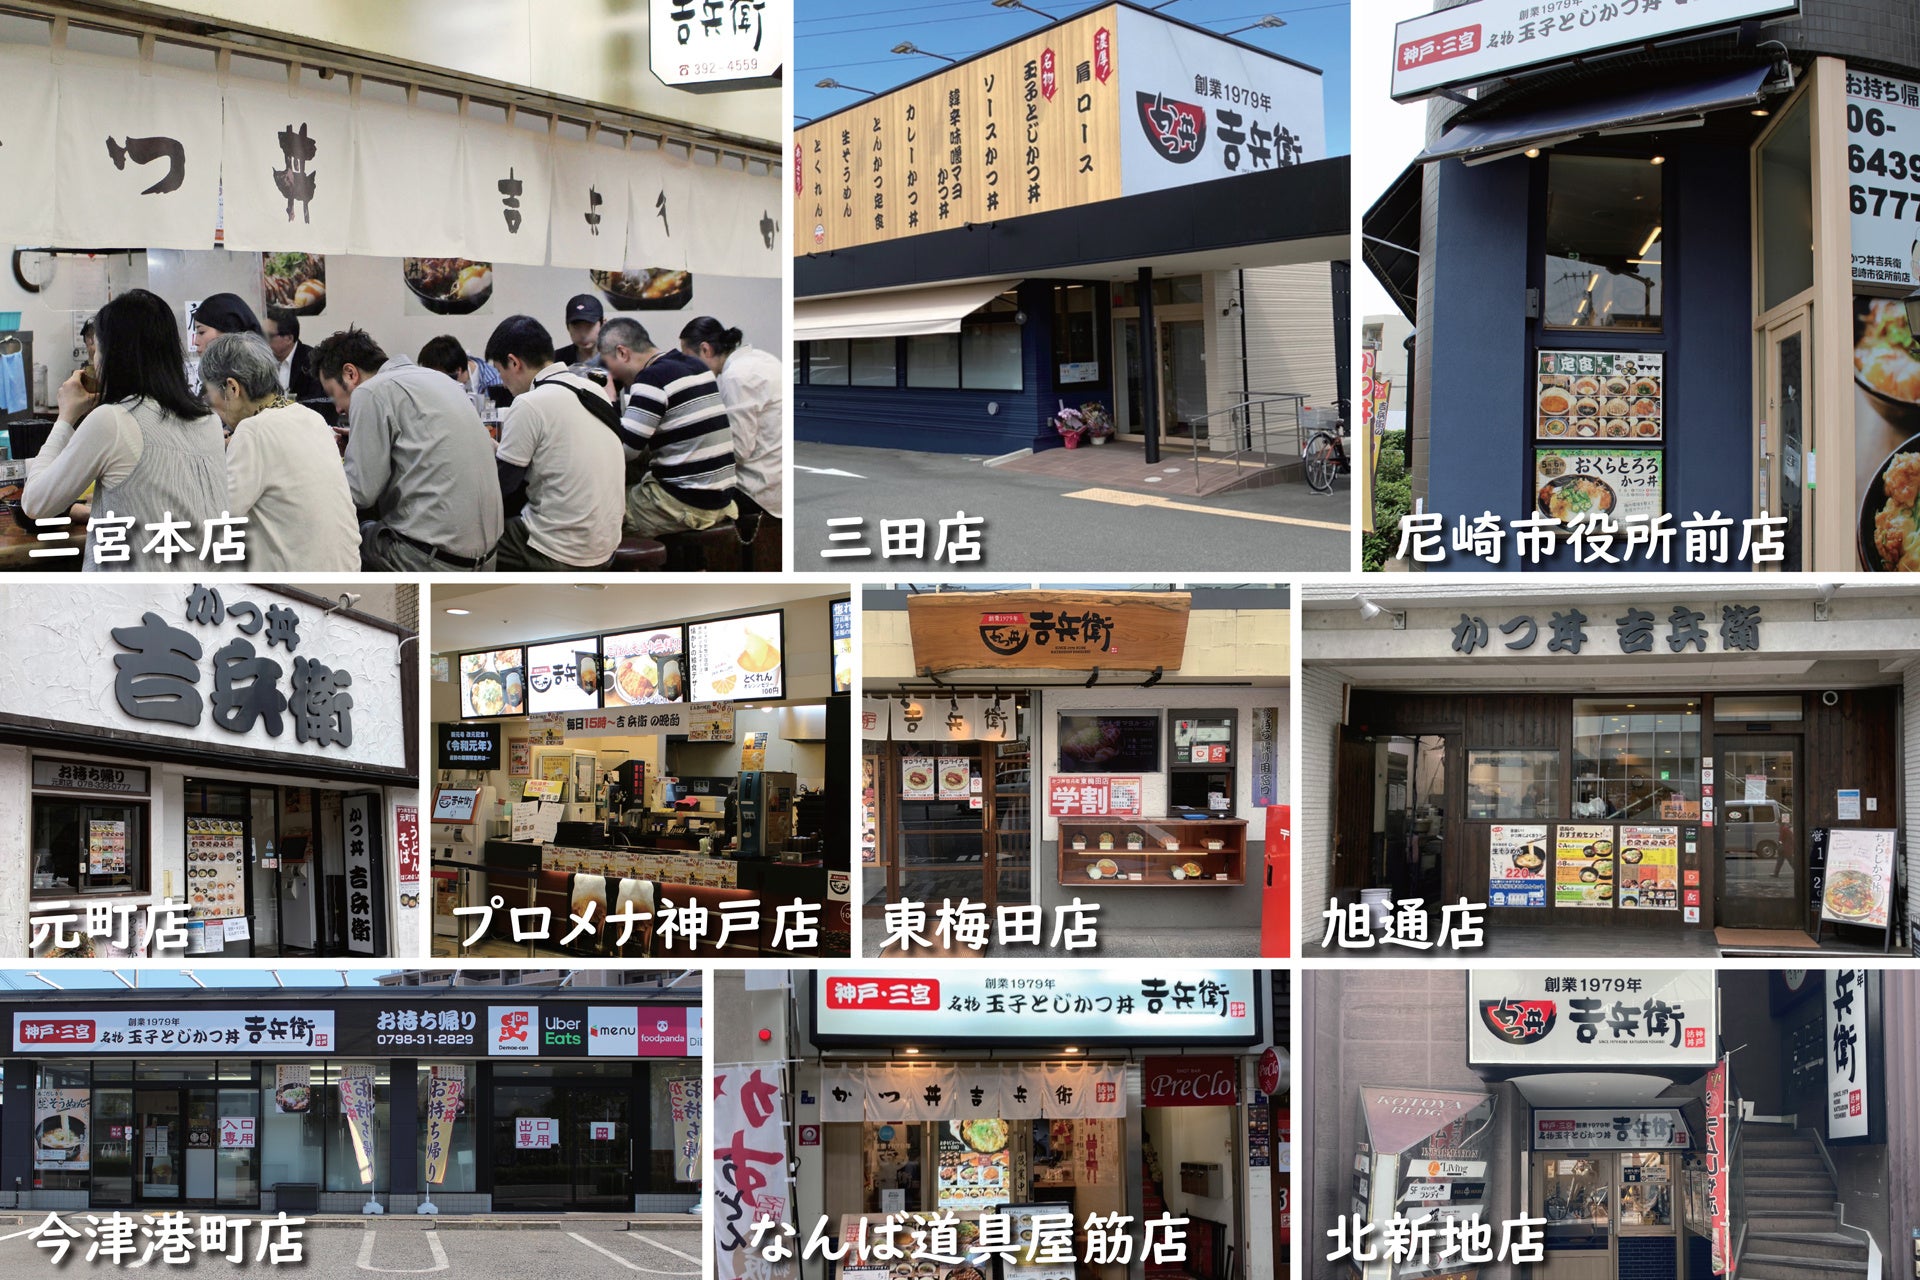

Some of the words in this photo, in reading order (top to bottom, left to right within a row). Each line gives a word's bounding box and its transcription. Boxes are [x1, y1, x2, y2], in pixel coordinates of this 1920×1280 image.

[1403, 31, 1475, 65] 神戸・三宮
[1486, 30, 1515, 49] 名物
[694, 58, 758, 75] 392-4559
[1194, 74, 1272, 113] 創業1979年
[1076, 61, 1094, 174] 肩ロース
[984, 74, 999, 211] ソースかつ丼
[1024, 60, 1040, 204] 玉子とじかつ丼
[1216, 109, 1303, 171] 吉兵衛
[841, 129, 851, 218] 生そうめん
[873, 117, 884, 230] とんかつ定食
[906, 104, 918, 228] カレーかつ丼
[814, 139, 823, 218] とくれん
[1576, 458, 1659, 474] おくらとろろ
[1621, 475, 1658, 487] かつ丼
[186, 584, 300, 652] かつ丼
[1451, 611, 1588, 655] かつ丼
[1616, 604, 1760, 653] 吉兵衛
[1029, 610, 1114, 652] 吉兵衛
[111, 611, 354, 748] 吉兵衛
[744, 673, 773, 683] とくれん
[904, 707, 1008, 738] 吉兵衛
[58, 765, 125, 783] お持ち帰り
[77, 780, 131, 790] 078-333-0777
[1052, 786, 1108, 814] 学割
[349, 808, 363, 857] かつ丼
[399, 833, 410, 864] そば
[349, 866, 371, 942] 吉兵衛
[835, 983, 931, 1005] 神戸・三宮
[985, 978, 1056, 990] 創業1979年
[1544, 977, 1642, 993] 創業1979年
[947, 995, 980, 1012] 名物
[985, 993, 1135, 1015] 玉子とじかつ丼
[1141, 978, 1230, 1017] 吉兵衛
[128, 1018, 180, 1026] 創業1979年
[377, 1010, 476, 1031] お持ち帰り
[515, 1015, 527, 1023] De
[545, 1016, 581, 1031] Uber
[1493, 996, 1546, 1039] かつ丼
[1569, 997, 1685, 1048] 吉兵衛
[25, 1024, 90, 1040] 神戸・三宮
[100, 1031, 124, 1043] 名物
[128, 1029, 240, 1045] 玉子とじかつ丼
[244, 1016, 316, 1046] 吉兵衛
[377, 1034, 474, 1045] 0798-31-2829
[545, 1032, 581, 1045] Eats
[600, 1026, 636, 1036] menu
[641, 1034, 685, 1043] foodpanda
[1151, 1070, 1231, 1099] PreClo
[442, 1081, 461, 1122] かつ丼
[1377, 1096, 1462, 1110] KOTOYA
[1392, 1107, 1441, 1117] BLDG
[222, 1120, 253, 1130] 入口
[427, 1080, 447, 1181] お持ち帰り
[519, 1120, 549, 1132] 出口
[1613, 1116, 1676, 1143] 吉兵衛
[221, 1133, 254, 1145] 専用
[518, 1134, 549, 1146] 専用
